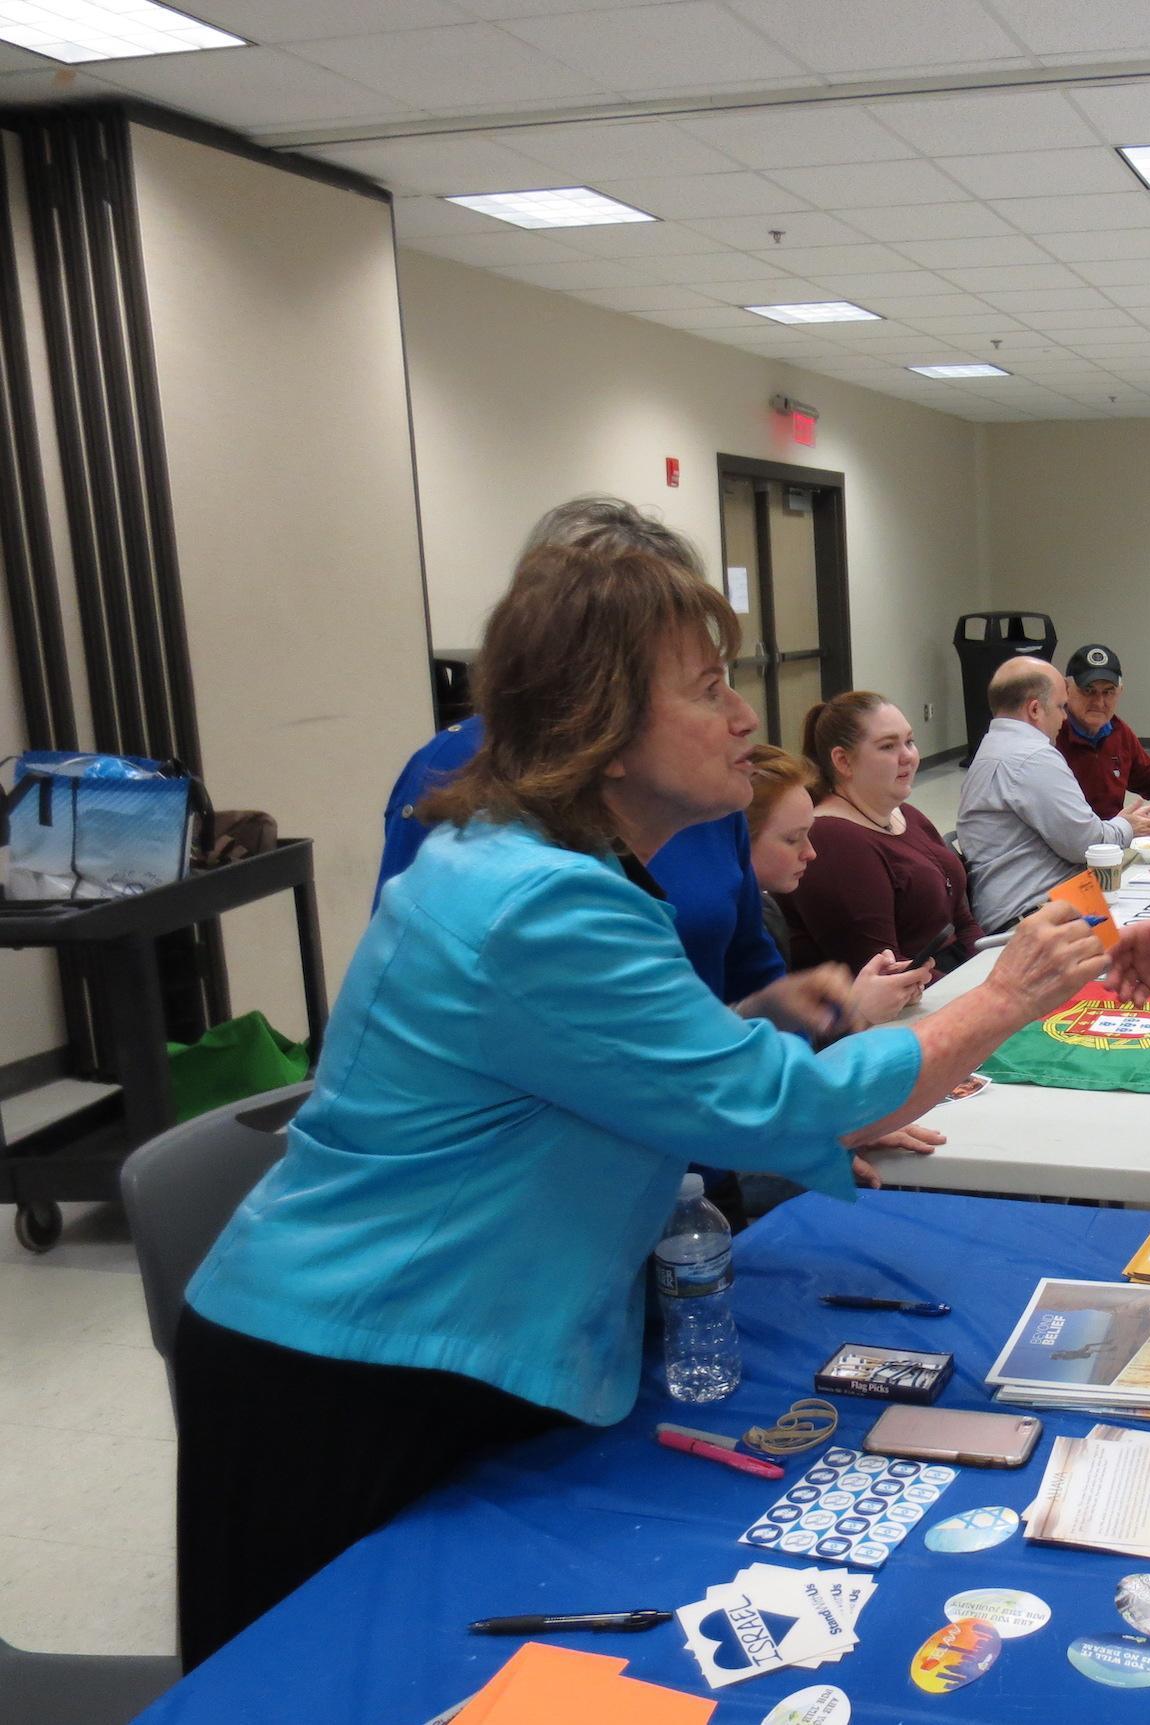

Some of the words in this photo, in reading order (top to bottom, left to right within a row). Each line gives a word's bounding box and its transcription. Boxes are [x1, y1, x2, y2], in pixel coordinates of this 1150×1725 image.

[1030, 1313, 1054, 1345] BEYOND
[1041, 1315, 1067, 1346] BELIEF
[851, 1381, 868, 1393] Flag
[869, 1383, 889, 1394] Picks
[728, 1593, 783, 1667] ISRAEL
[1095, 1653, 1121, 1665] WILL
[1123, 1653, 1139, 1661] NO
[1124, 1660, 1145, 1671] YOU
